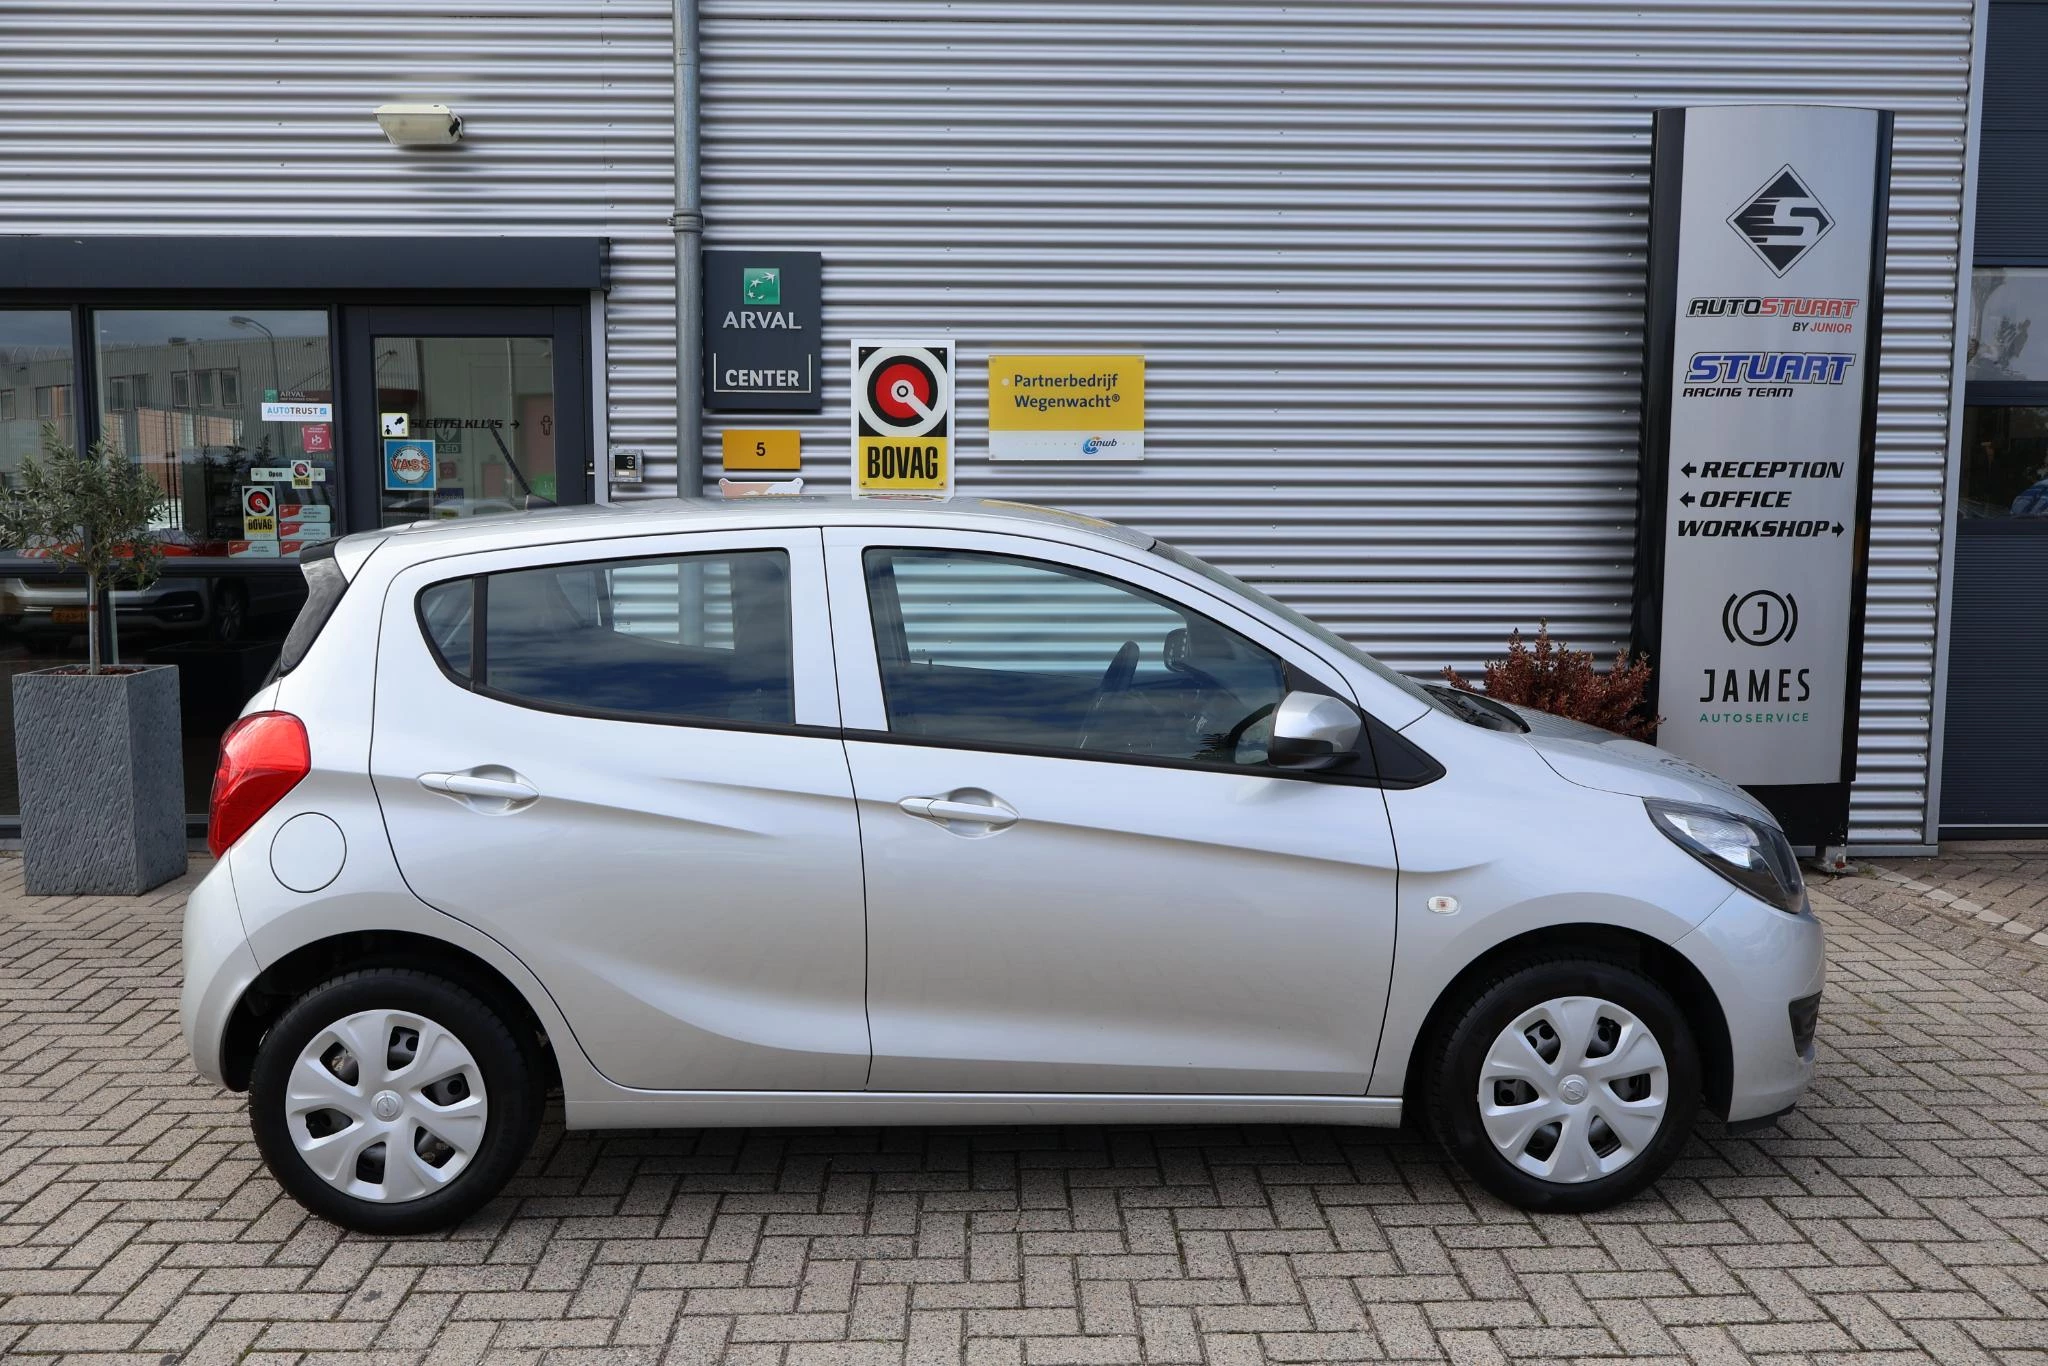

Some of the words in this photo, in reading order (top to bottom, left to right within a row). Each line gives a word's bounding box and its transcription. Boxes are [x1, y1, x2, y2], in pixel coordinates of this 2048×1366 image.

[1686, 297, 1859, 318] AUTOSTUART
[722, 311, 802, 329] ARVAL
[1792, 322, 1809, 332] BY
[1810, 323, 1852, 333] JUNIOR
[1685, 352, 1856, 384] STUART
[725, 369, 799, 387] CENTER
[1014, 374, 1118, 391] Partnerbedrijf
[1683, 387, 1742, 398] RACING
[1747, 387, 1793, 398] TEAM
[266, 406, 318, 415] AUTOTRUST
[438, 445, 459, 453] AED
[755, 442, 766, 457] 5
[1090, 438, 1117, 447] anwb
[867, 446, 938, 480] BOVAG
[1700, 461, 1844, 478] RECEPTION
[1700, 491, 1792, 508] OFFICE
[248, 518, 272, 531] BOVAG
[1678, 520, 1830, 537] WORKSHOP
[1700, 668, 1811, 702] JAMES
[1700, 712, 1809, 723] AUTOSERVICE
